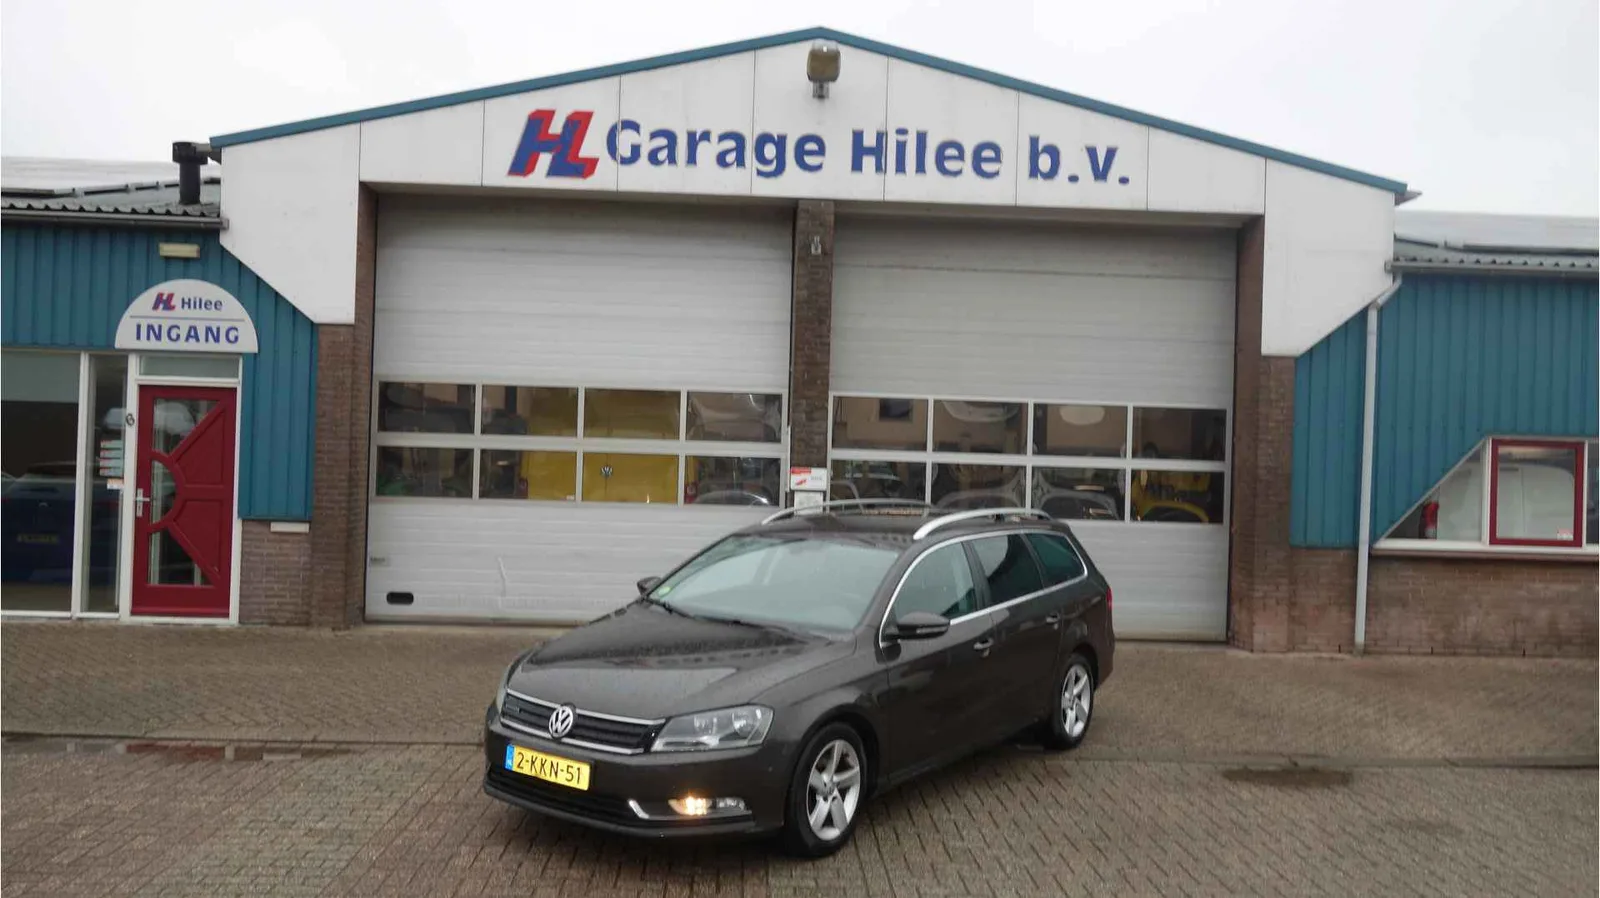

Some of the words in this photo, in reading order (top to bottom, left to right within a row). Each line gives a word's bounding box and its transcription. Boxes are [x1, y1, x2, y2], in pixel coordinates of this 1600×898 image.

[606, 119, 826, 178] Garage
[851, 128, 1003, 178] Hilee
[1028, 136, 1131, 185] b.v.
[181, 297, 223, 311] Hilee
[136, 323, 239, 344] INGANG
[517, 752, 582, 784] 2-KKN-51
